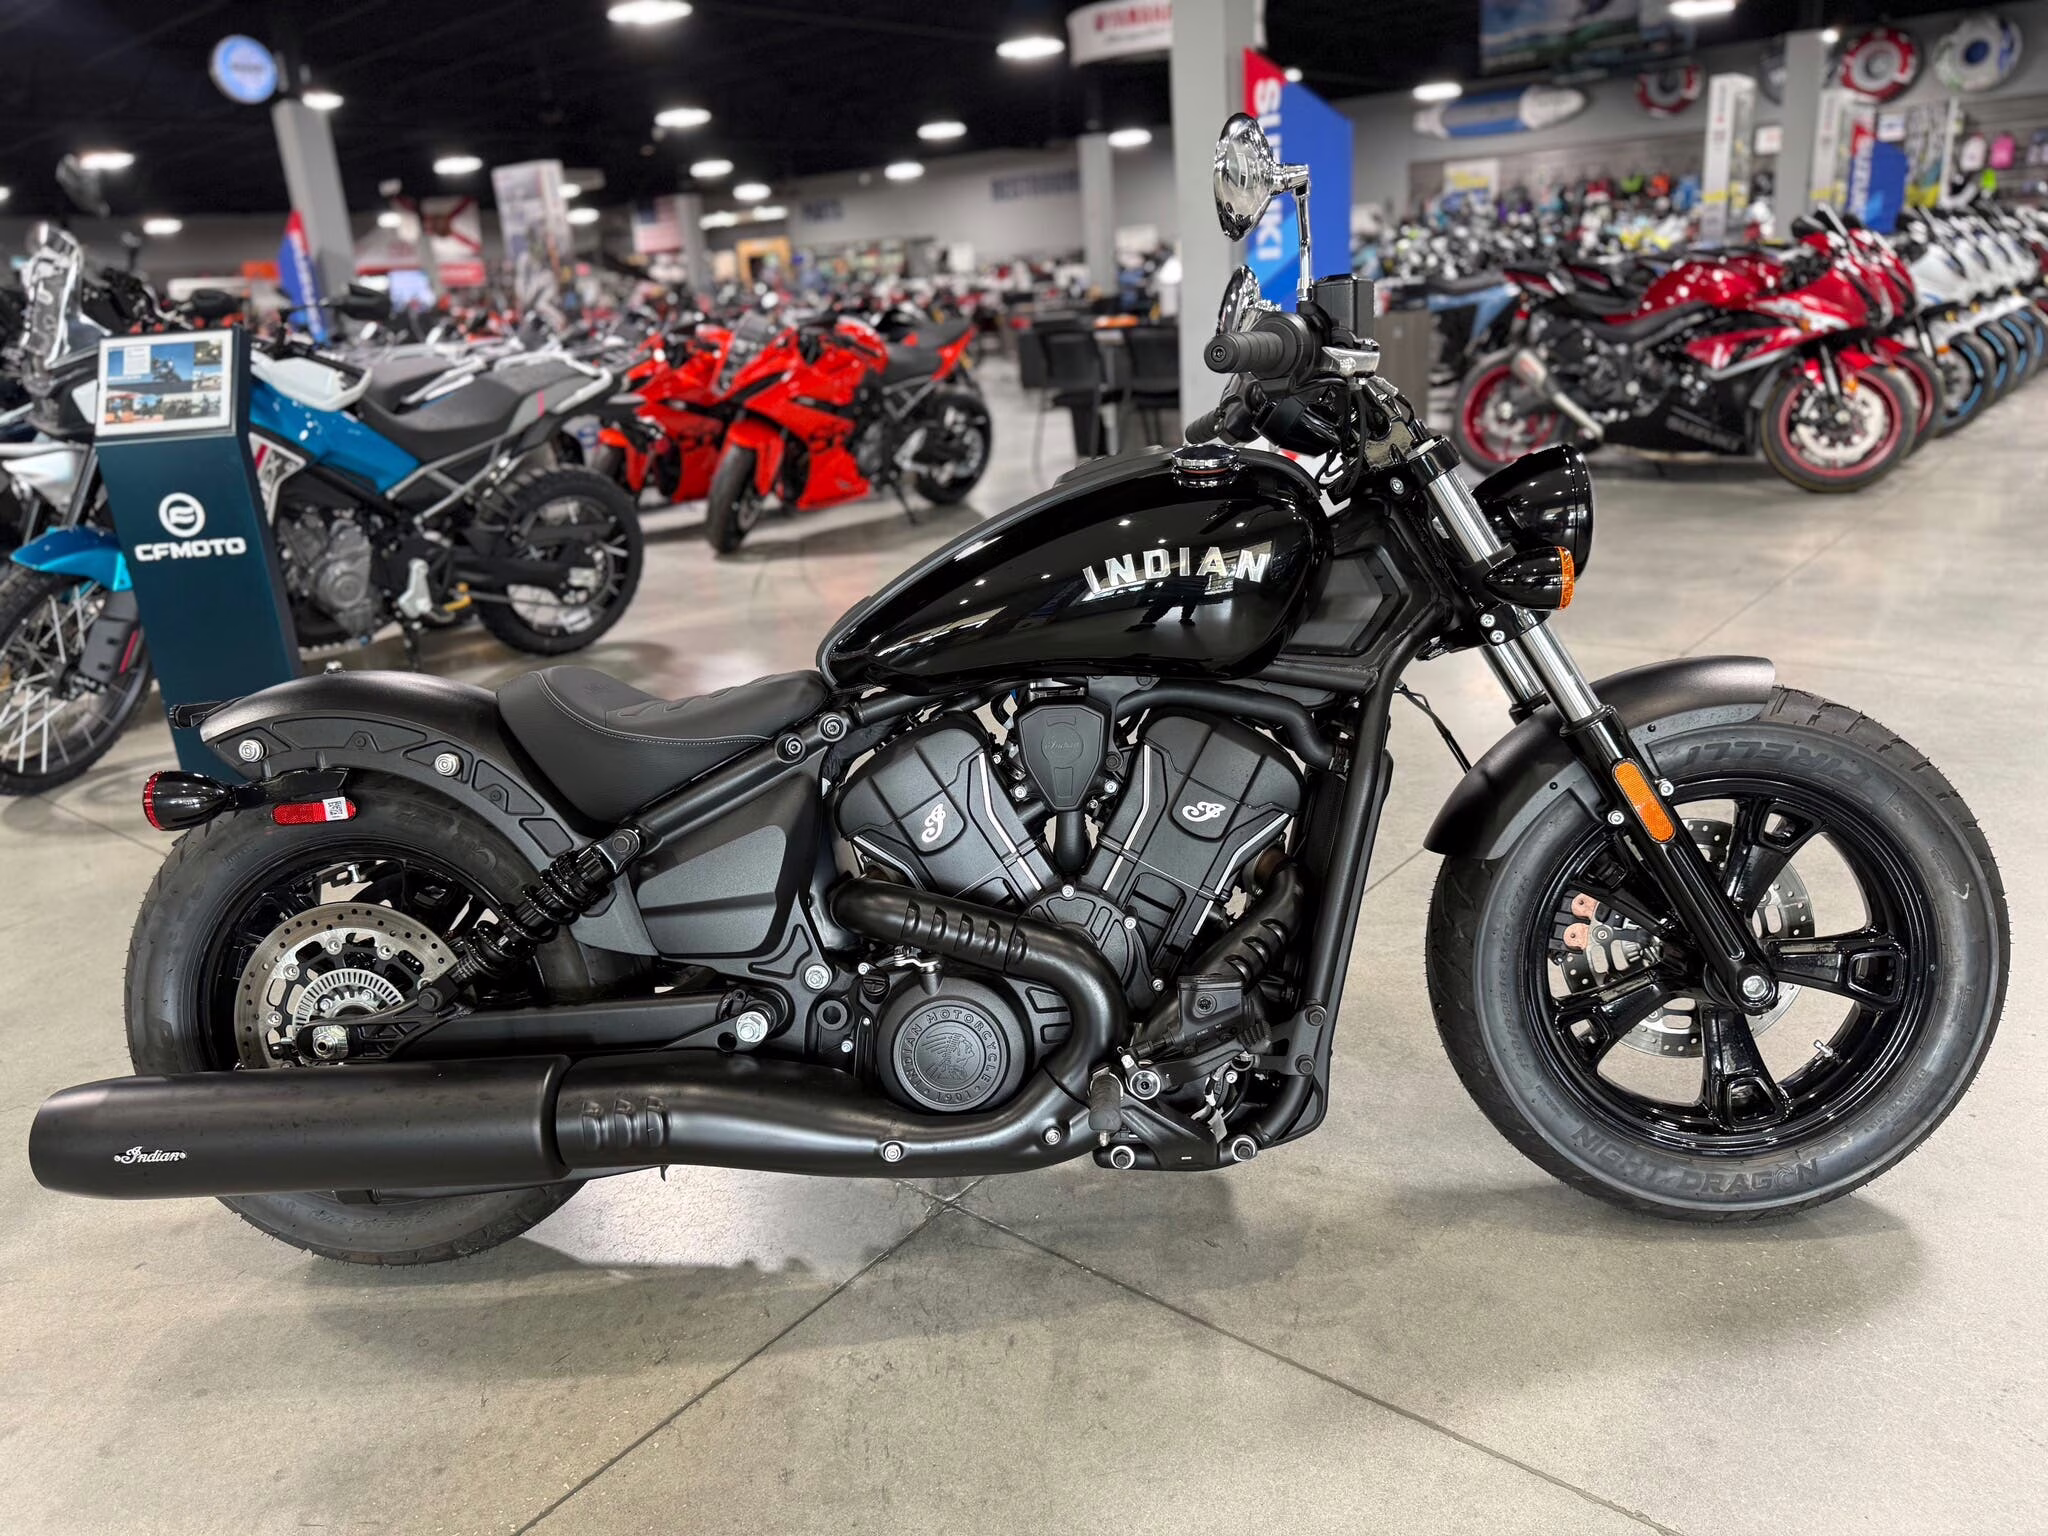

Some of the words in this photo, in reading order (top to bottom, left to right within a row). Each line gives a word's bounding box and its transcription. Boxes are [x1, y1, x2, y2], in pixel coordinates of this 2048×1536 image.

[1253, 77, 1283, 261] SUKI
[134, 536, 247, 562] CFMOTO
[1082, 546, 1272, 594] INDIAN
[903, 1023, 923, 1087] INDIAN
[926, 1009, 998, 1083] MOTORCYCLE
[936, 1089, 973, 1102] 1901
[119, 1146, 181, 1164] Indian
[1678, 1157, 1818, 1194] DRAGON
